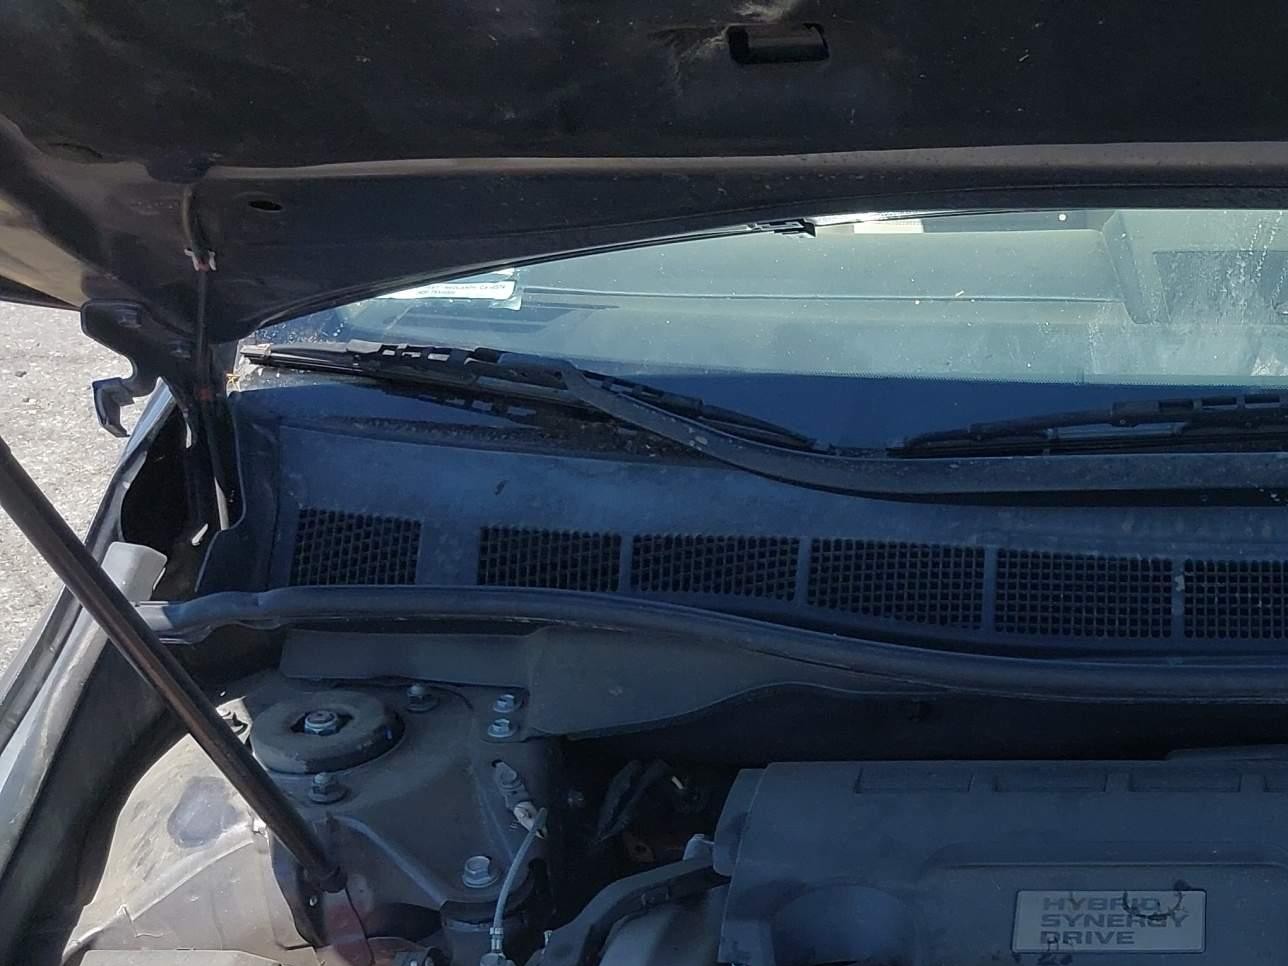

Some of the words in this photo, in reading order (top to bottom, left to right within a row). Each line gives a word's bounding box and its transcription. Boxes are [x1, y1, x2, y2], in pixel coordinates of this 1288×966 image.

[1043, 897, 1161, 911] HYBRID
[1041, 913, 1189, 928] SYNERGY
[1040, 931, 1135, 945] DRIVE
